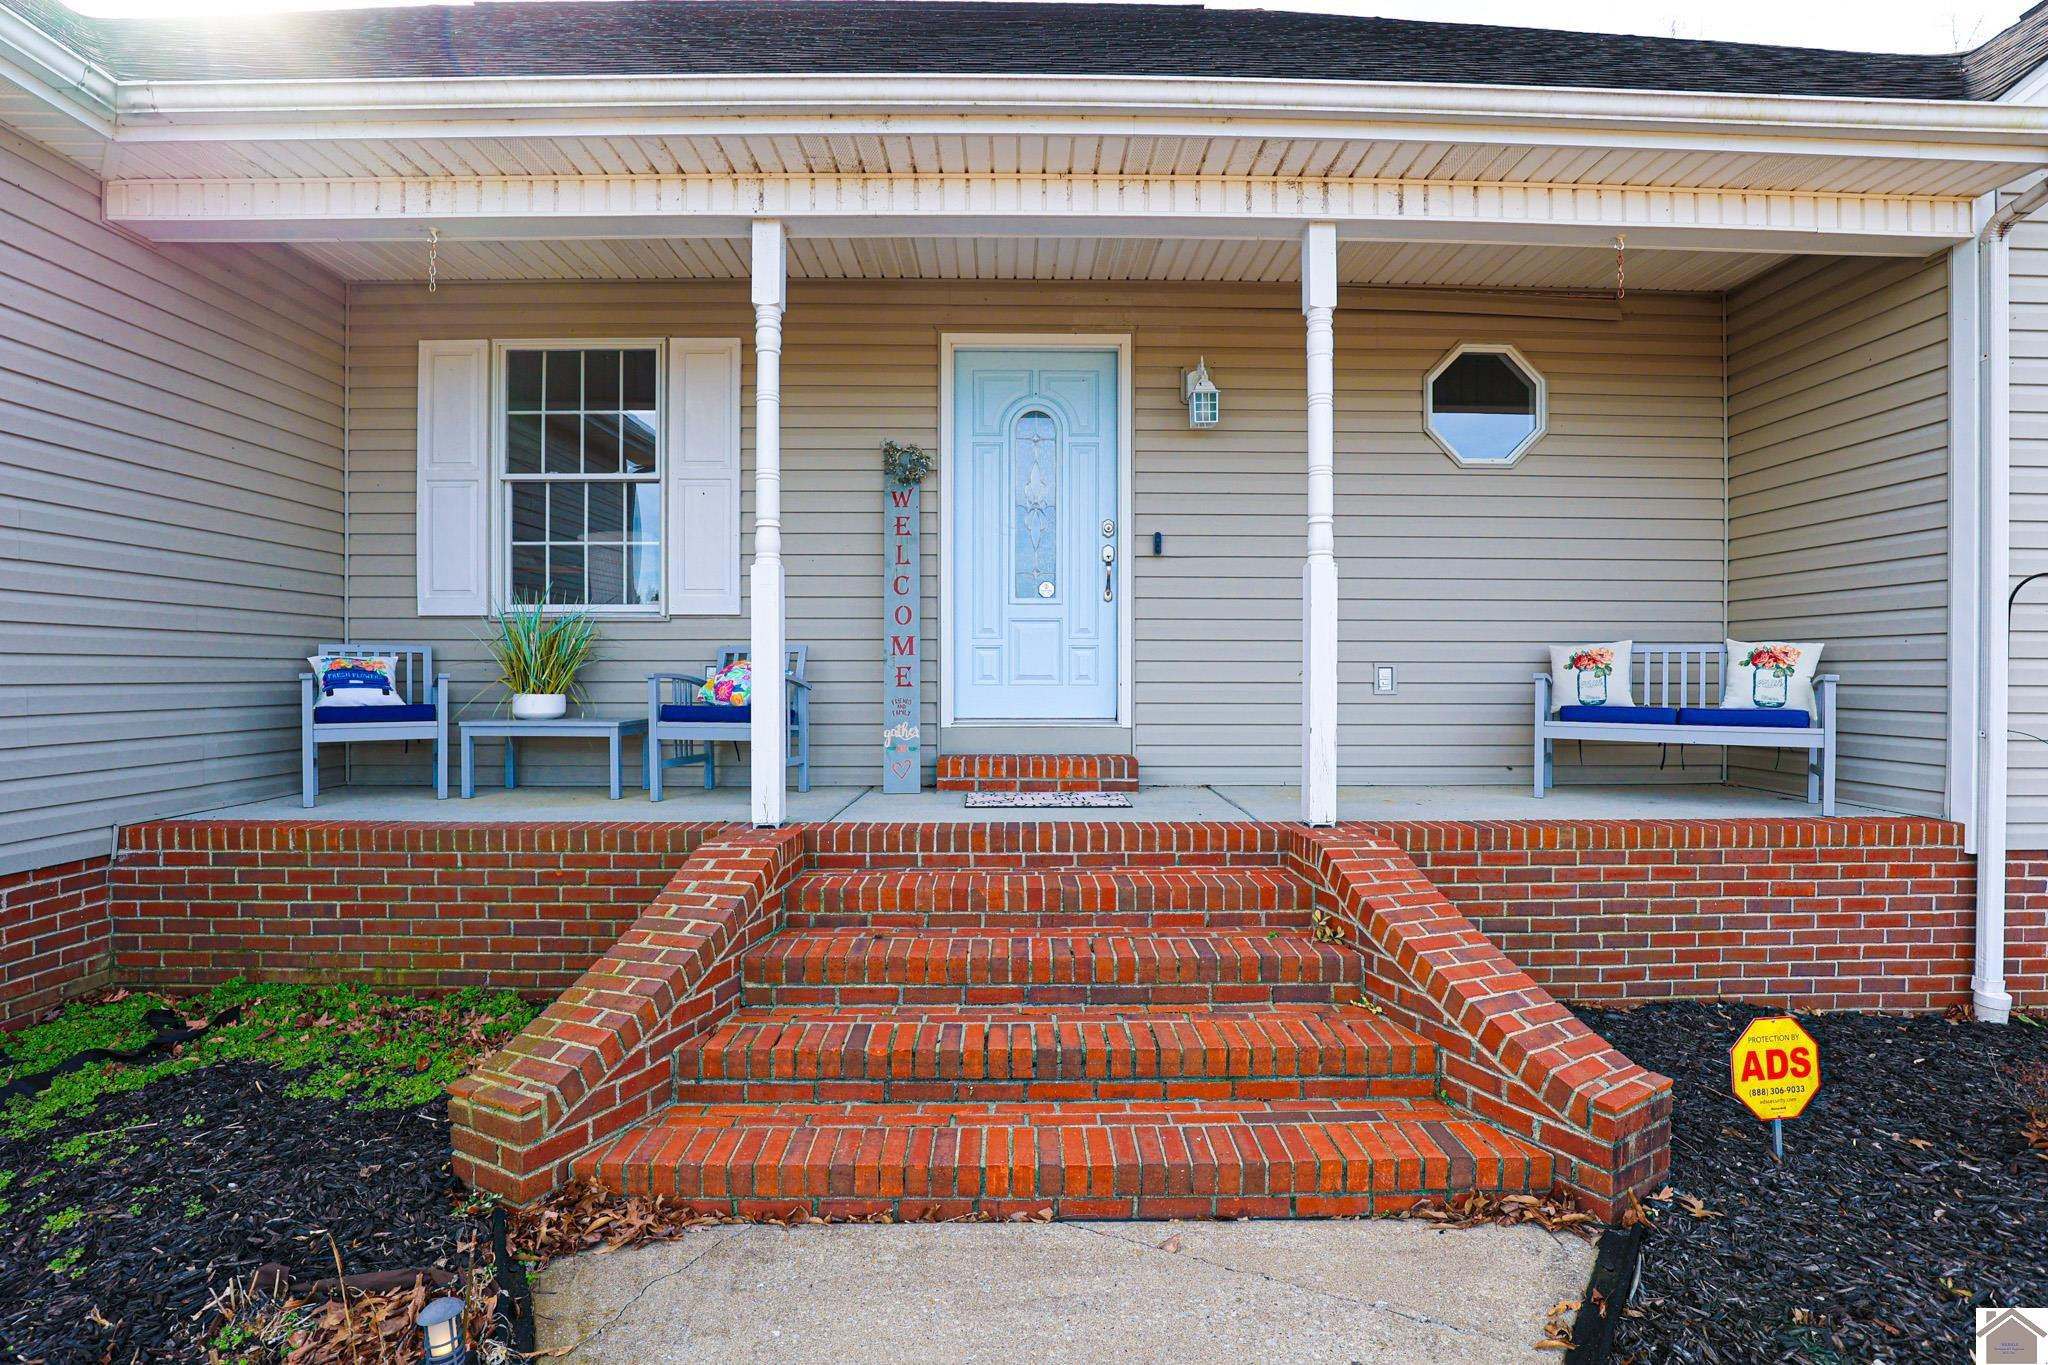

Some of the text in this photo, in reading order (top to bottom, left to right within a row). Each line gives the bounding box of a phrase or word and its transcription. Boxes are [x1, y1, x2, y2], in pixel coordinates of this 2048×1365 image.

[890, 487, 916, 688] WELCOME
[892, 709, 911, 717] FAMILY
[1748, 1034, 1790, 1044] PROTECTION
[1741, 1047, 1811, 1082] ADS
[1750, 1085, 1805, 1097] (888) 306-9033
